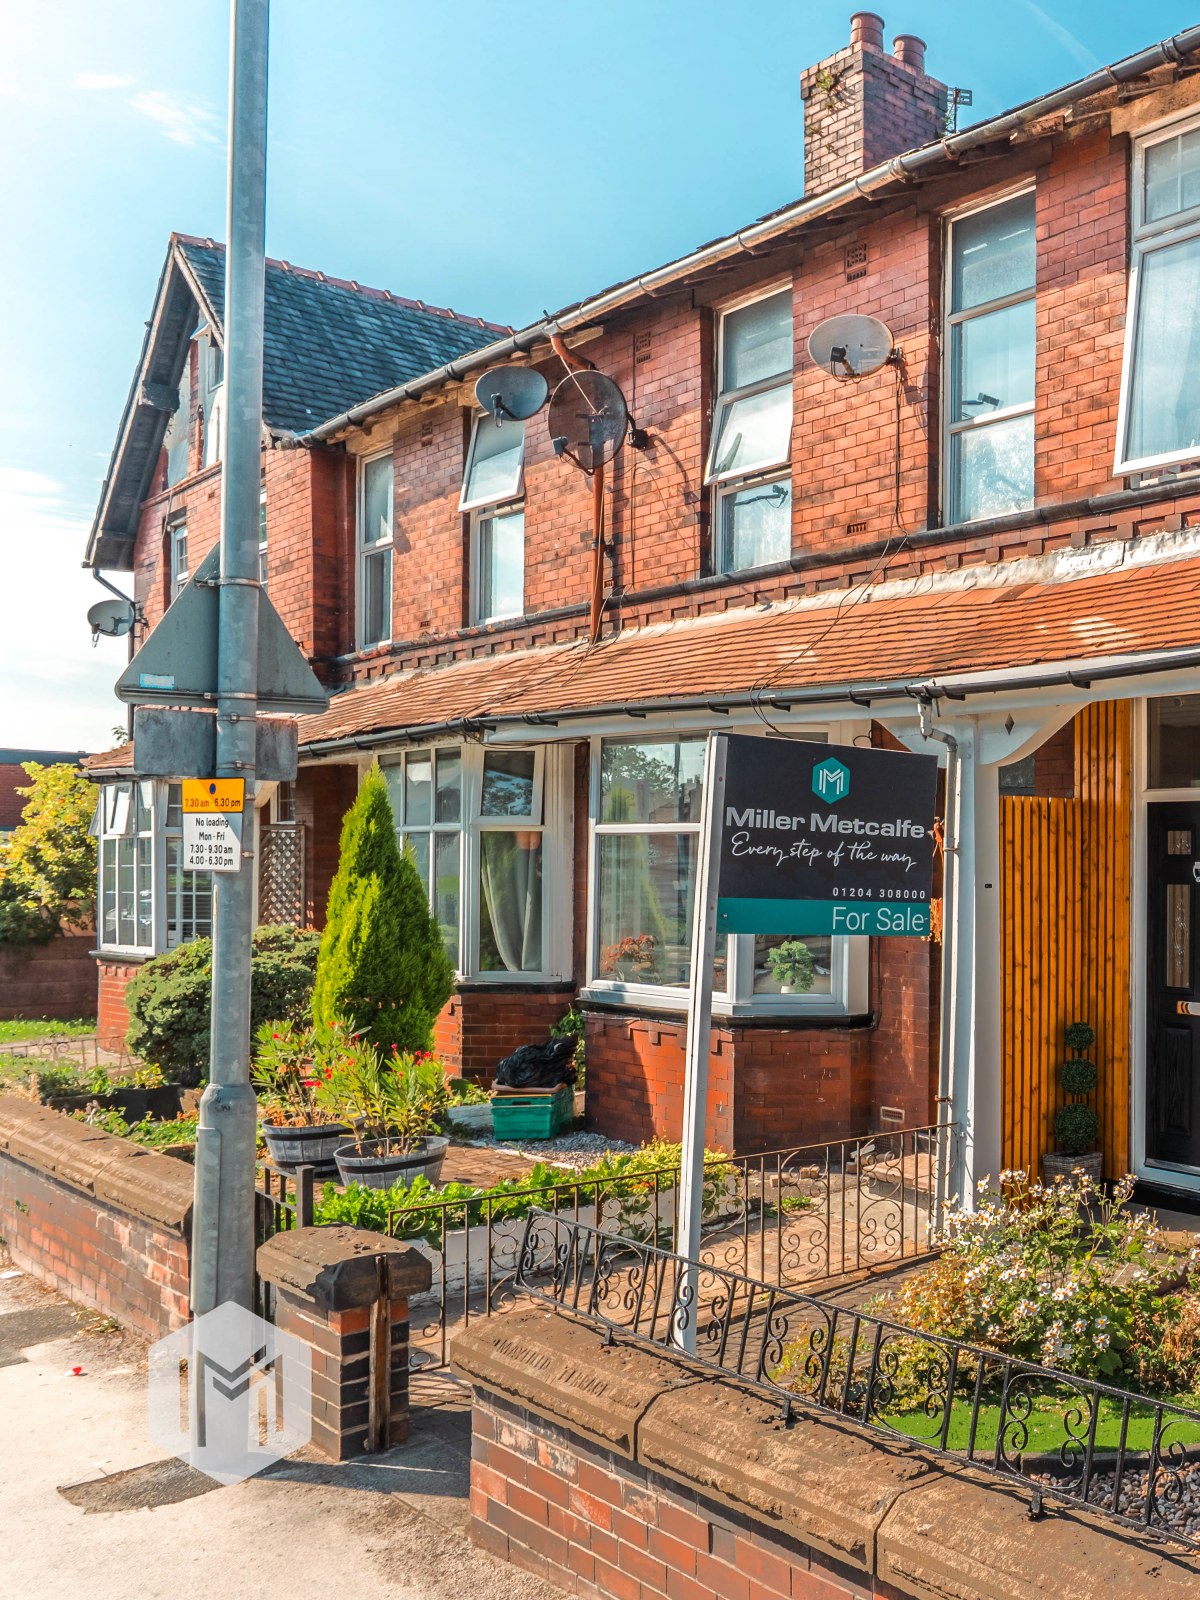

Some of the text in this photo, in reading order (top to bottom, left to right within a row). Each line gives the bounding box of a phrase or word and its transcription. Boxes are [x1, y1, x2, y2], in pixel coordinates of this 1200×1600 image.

[185, 799, 199, 807] 7.30
[214, 798, 230, 807] 6.30
[231, 799, 241, 808] pm
[196, 818, 229, 828] No loading
[726, 807, 925, 839] Miller Metcalfe
[199, 832, 212, 841] Mon
[217, 832, 225, 841] Fri
[190, 845, 204, 854] 7.30
[208, 845, 223, 854] 9.30
[731, 831, 917, 873] Every step of the way
[190, 856, 204, 865] 4.00
[209, 856, 223, 865] 6.30
[224, 858, 233, 867] pm
[833, 887, 926, 899] 01204 308000
[832, 906, 925, 932] For Sale
